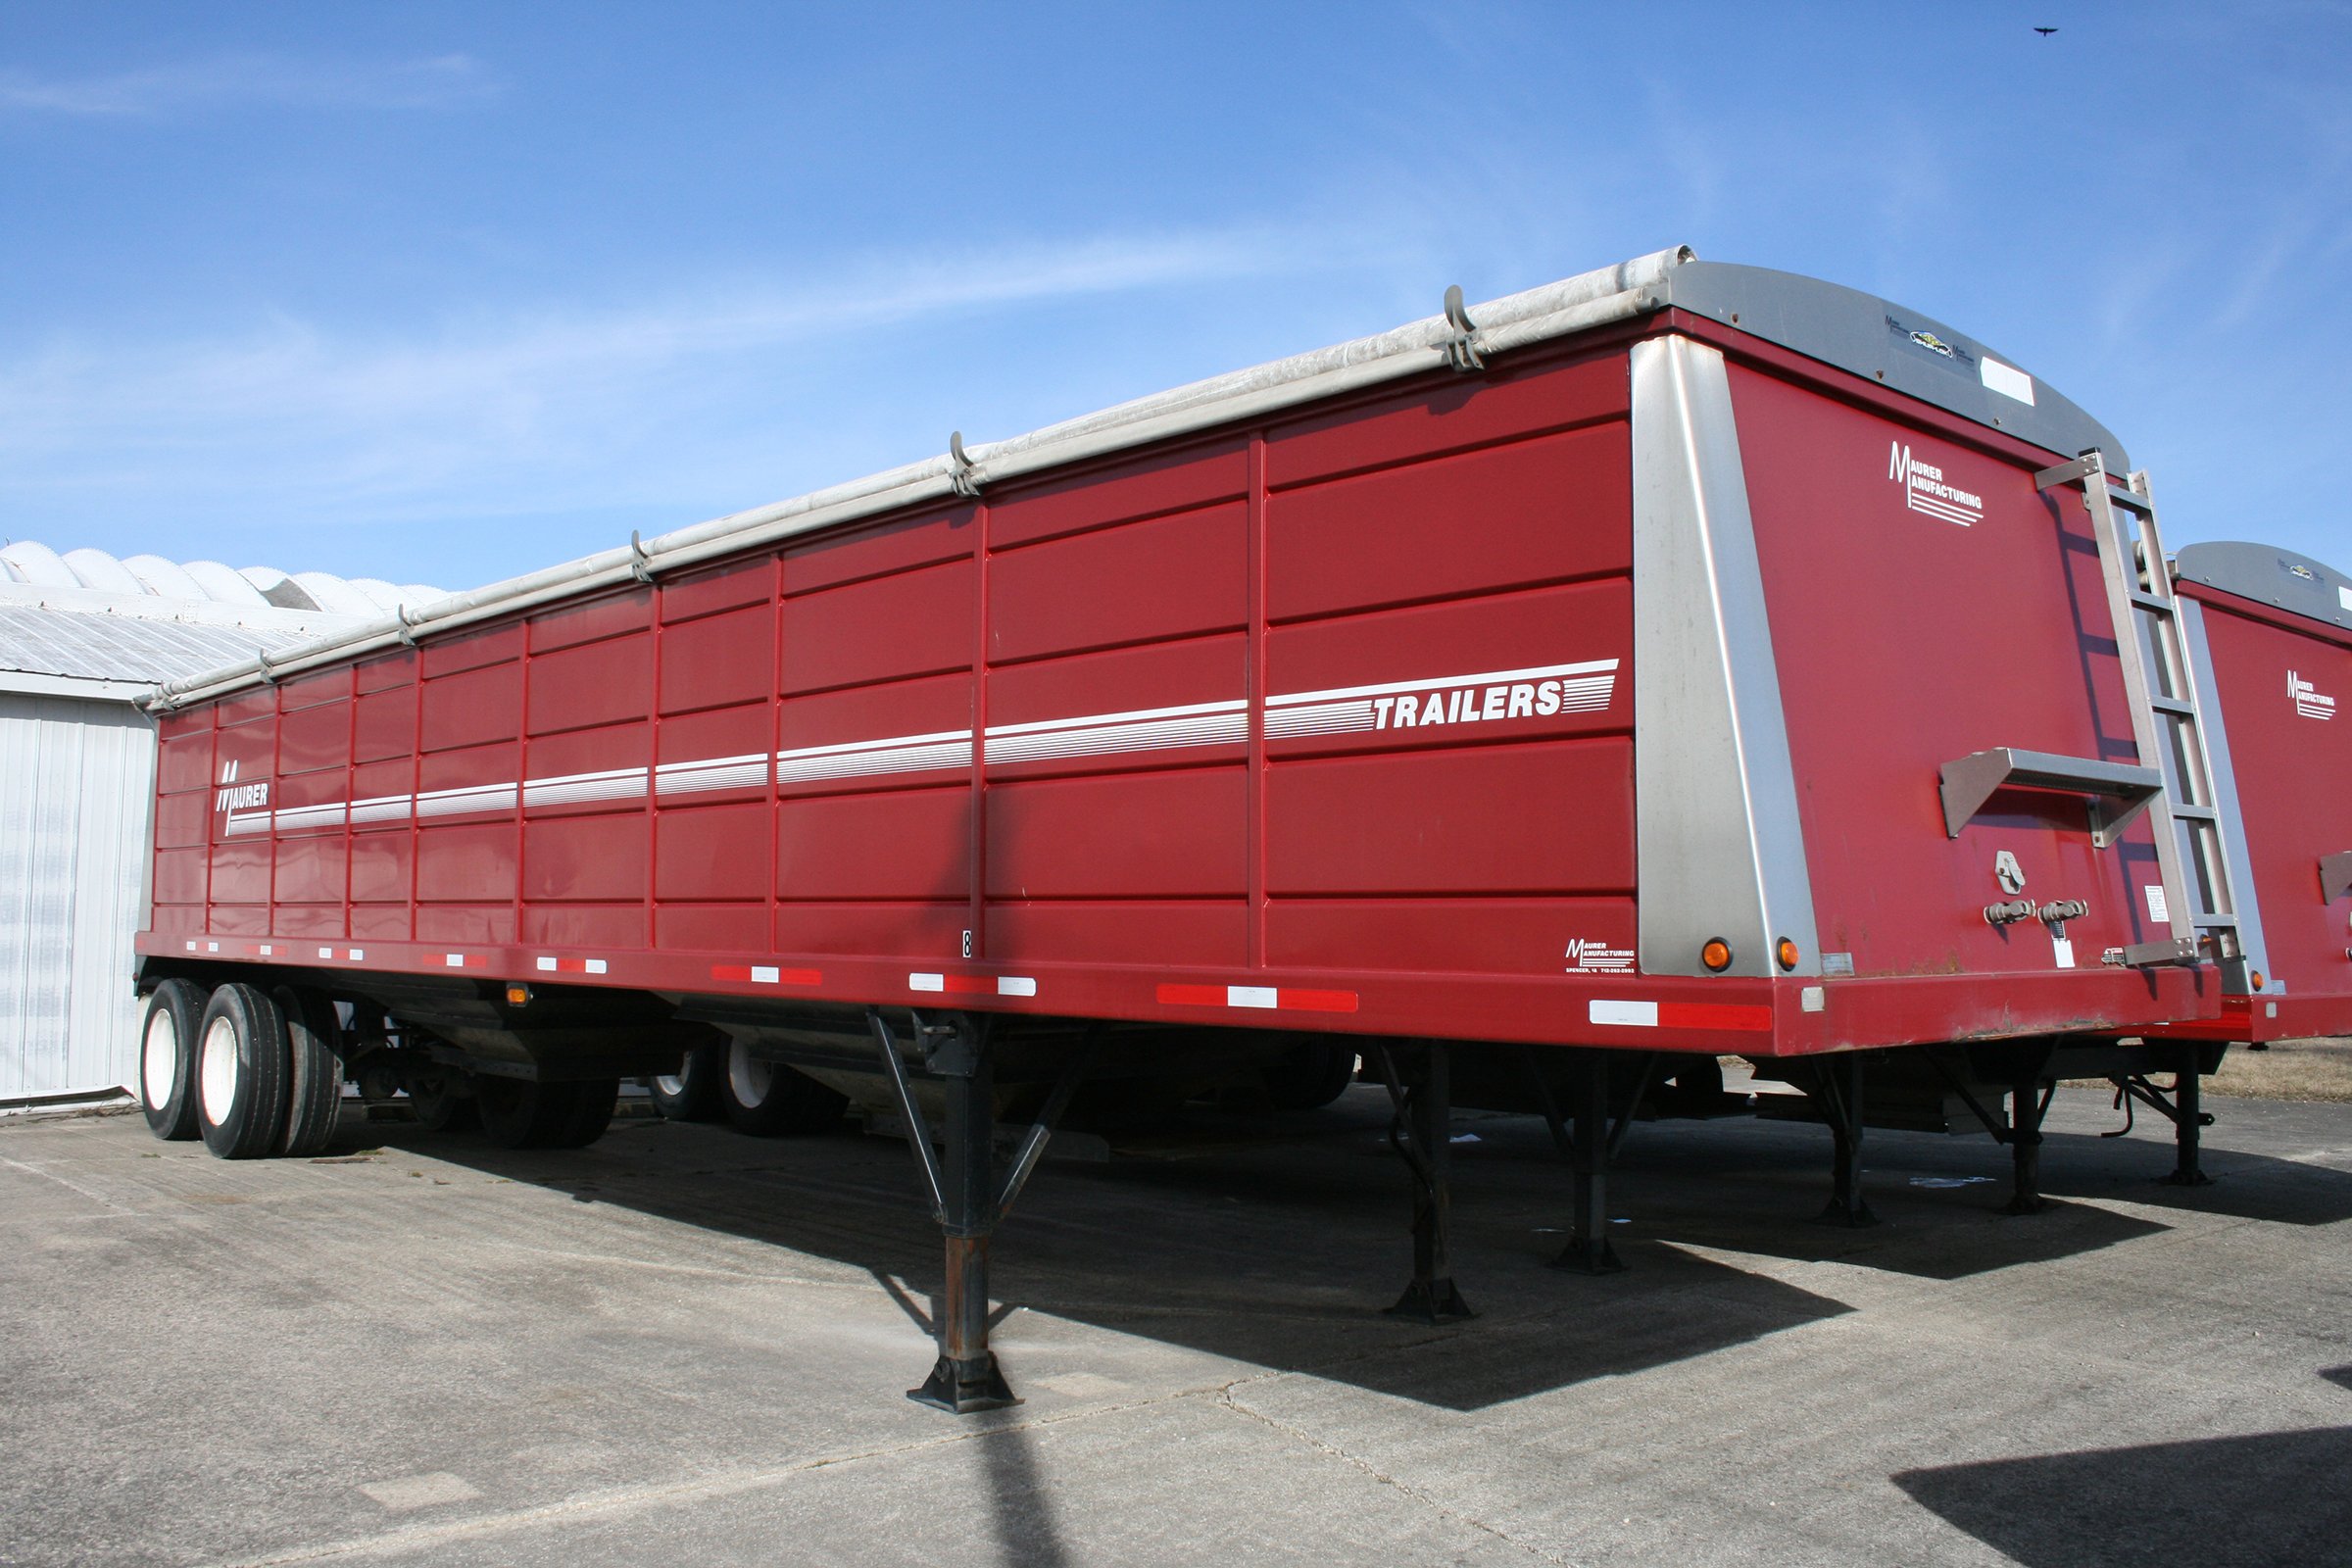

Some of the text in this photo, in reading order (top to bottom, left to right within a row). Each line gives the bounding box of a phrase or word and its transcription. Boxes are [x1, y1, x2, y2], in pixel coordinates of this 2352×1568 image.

[1889, 441, 1942, 509] MAURER
[1373, 680, 1561, 730] TRAILERS
[216, 760, 269, 837] MAURER
[964, 932, 971, 956] 8
